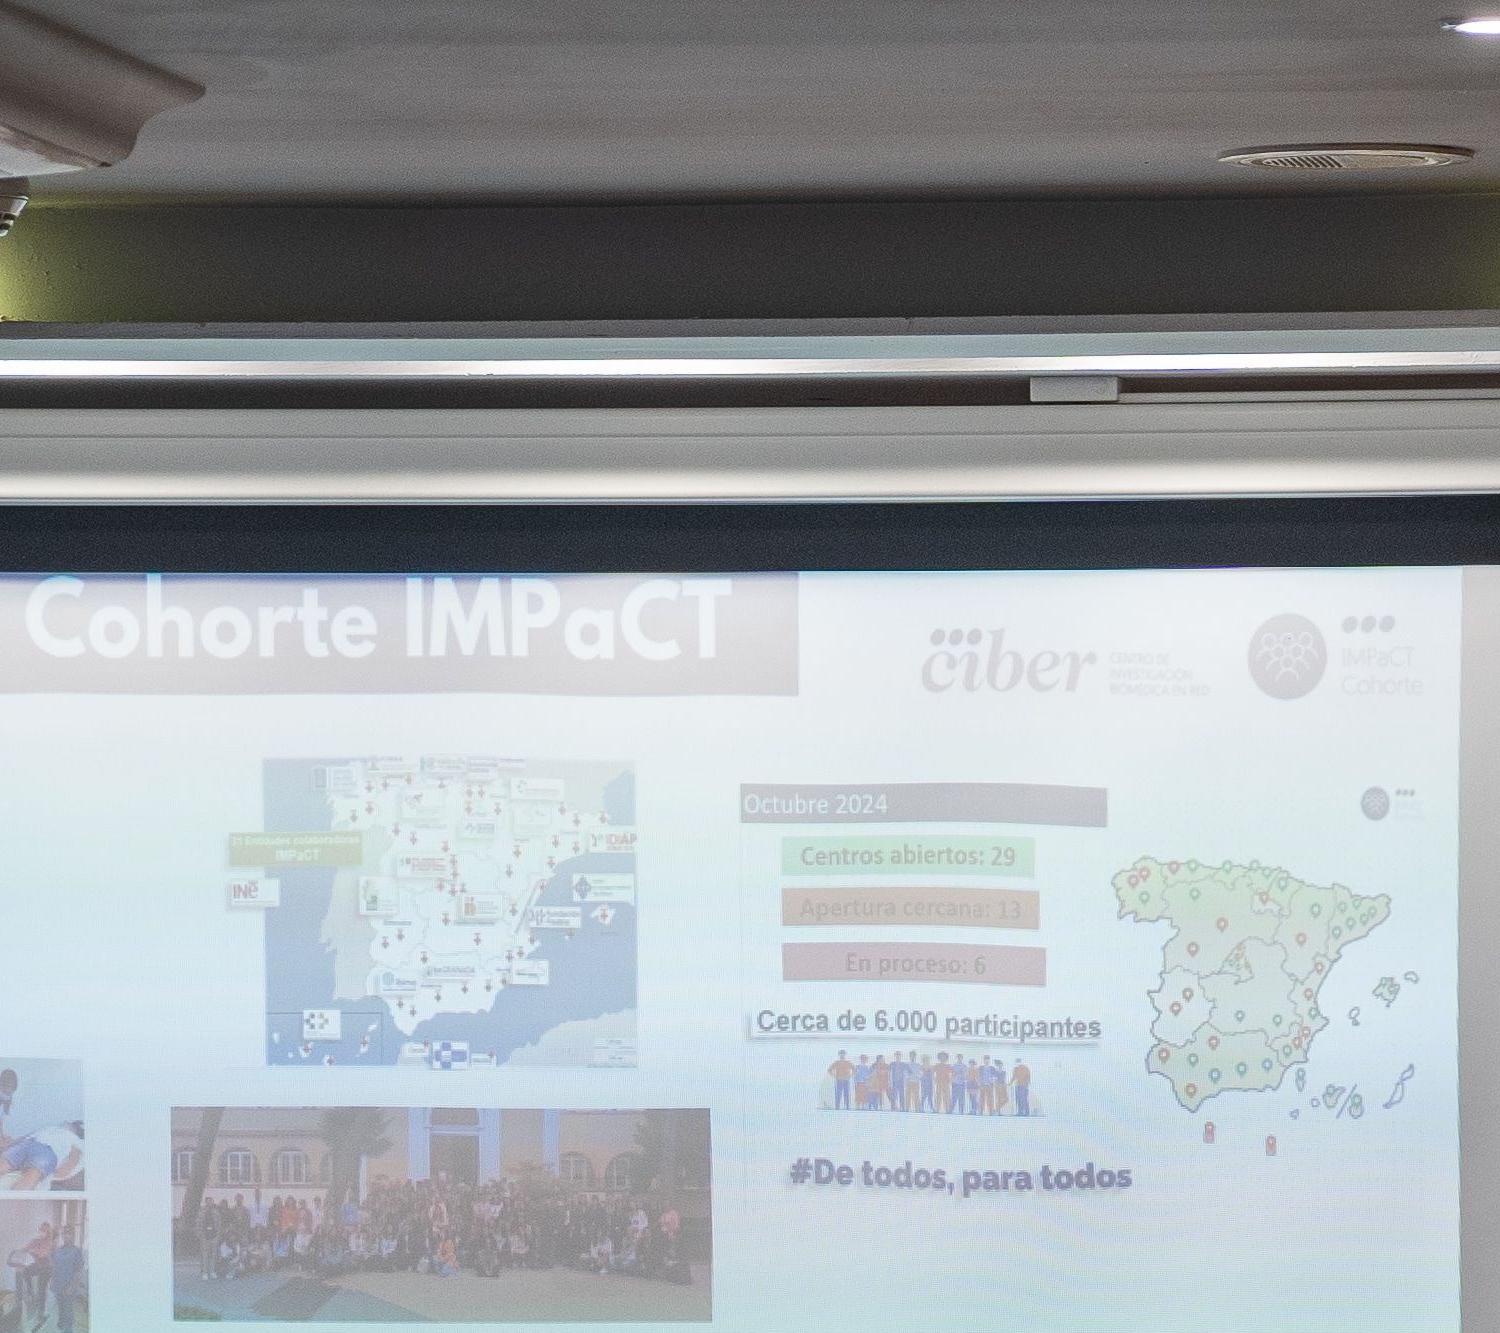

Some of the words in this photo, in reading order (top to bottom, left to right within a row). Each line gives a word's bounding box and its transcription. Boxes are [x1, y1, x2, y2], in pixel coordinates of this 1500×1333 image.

[26, 572, 378, 661] Cohorte
[406, 576, 733, 661] IMPaCT
[921, 627, 1097, 694] ciber
[1342, 647, 1414, 669] IMPaCT
[1342, 674, 1424, 696] Cohorte
[744, 792, 828, 815] Octubre
[836, 793, 888, 815] 2024
[801, 846, 884, 867] Centros
[891, 843, 985, 867] abiertos:
[991, 846, 1016, 867] 29
[800, 898, 897, 922] Apertura
[903, 900, 991, 920] cercana:
[999, 899, 1021, 920] 13
[845, 952, 872, 974] En
[879, 955, 968, 978] proceso:
[974, 954, 986, 976] 6
[757, 1010, 828, 1034] Cerca
[836, 1010, 865, 1034] de
[874, 1010, 936, 1034] 6.000
[945, 1012, 1101, 1042] participantes
[790, 1158, 853, 1187] #De
[861, 1160, 955, 1193] todos,
[962, 1167, 1031, 1196] para
[1038, 1162, 1133, 1190] todos
